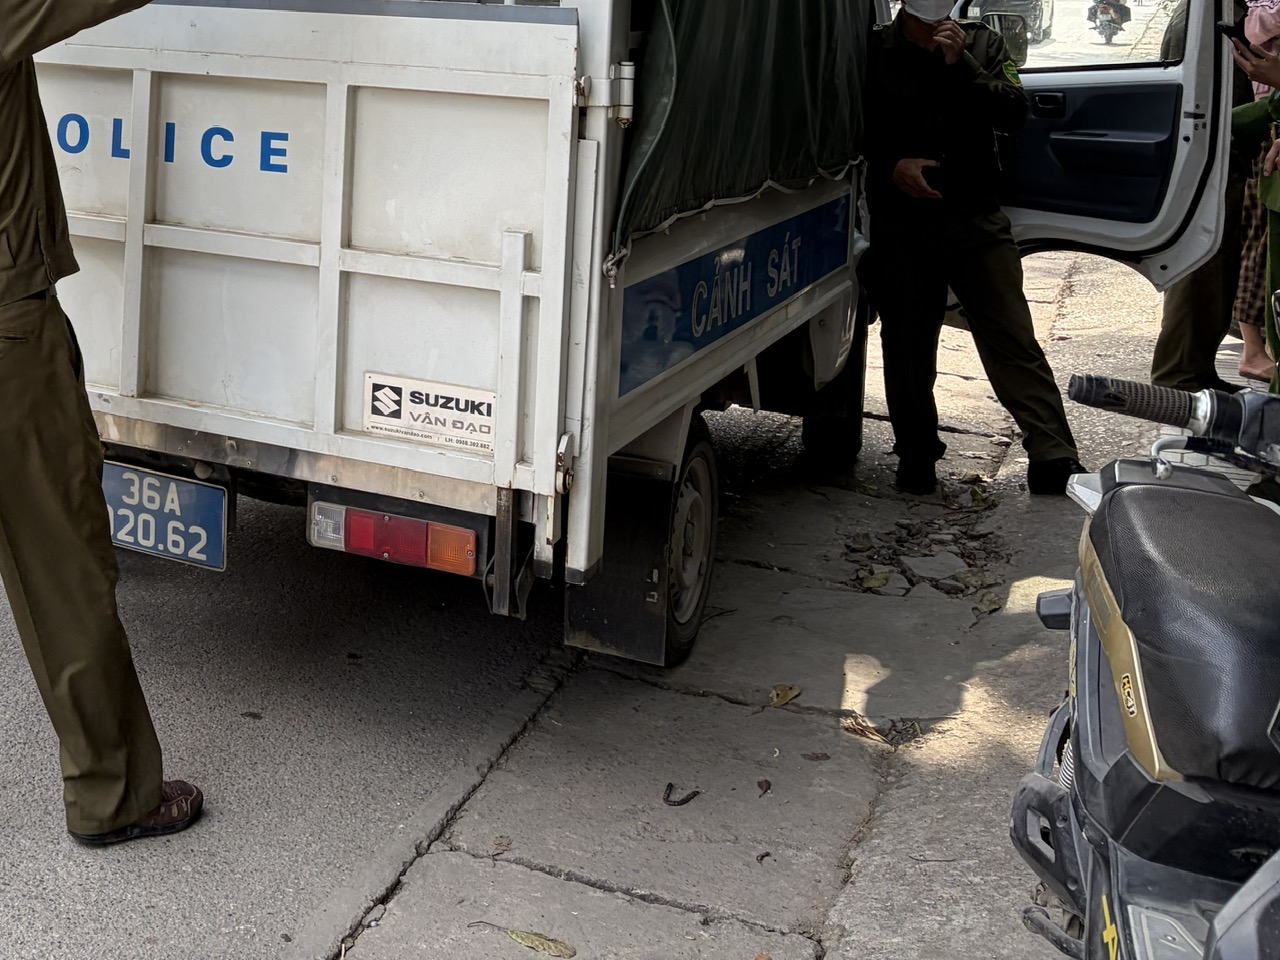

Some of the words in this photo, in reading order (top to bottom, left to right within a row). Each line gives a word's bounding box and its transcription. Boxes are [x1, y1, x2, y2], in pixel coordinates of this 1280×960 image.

[57, 113, 289, 173] OLICE
[692, 256, 752, 338] CẢNH
[766, 231, 801, 298] SÁT
[409, 390, 492, 417] SUZUKI
[370, 425, 433, 440] www.suzukivandao.com
[409, 411, 447, 428] VÂN
[451, 419, 491, 434] ĐẠO
[121, 471, 181, 516] 36A
